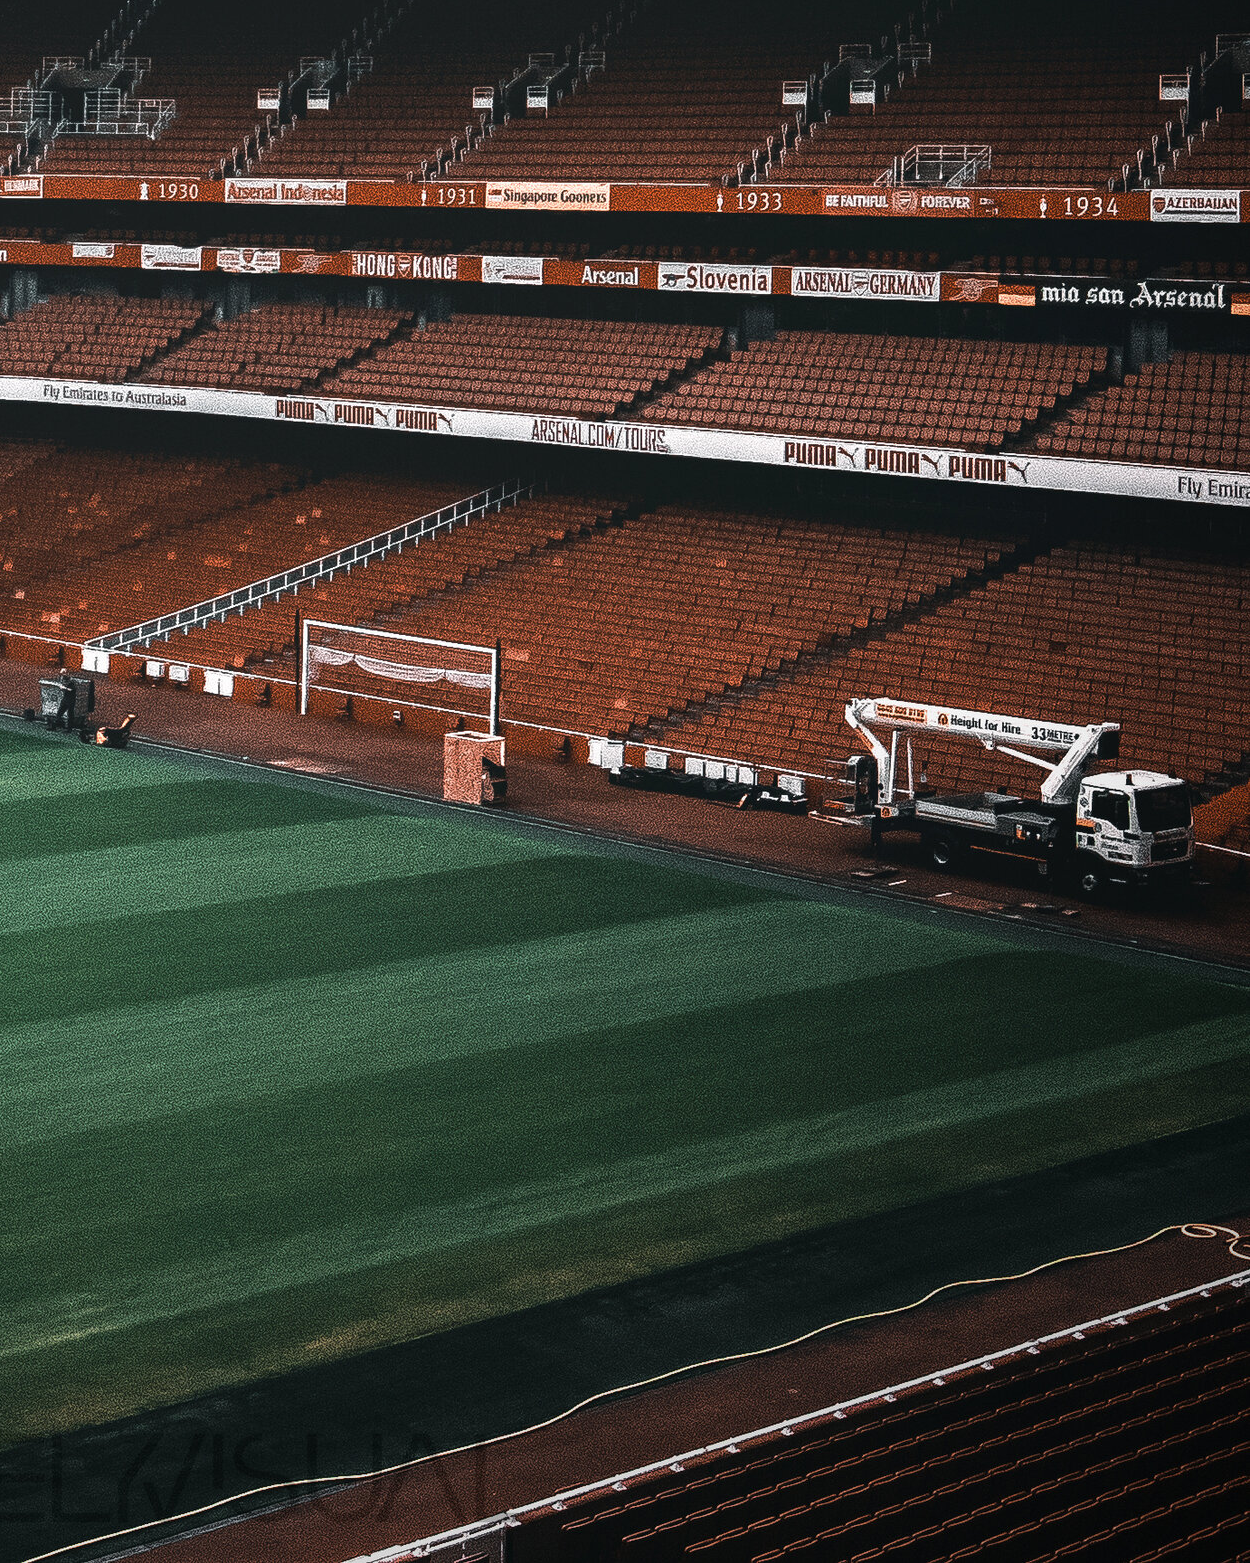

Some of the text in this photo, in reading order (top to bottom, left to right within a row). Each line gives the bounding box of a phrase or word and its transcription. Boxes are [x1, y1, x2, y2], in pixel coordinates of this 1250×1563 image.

[159, 183, 199, 199] 1930
[227, 182, 344, 201] Arsenal Indonesia
[438, 188, 476, 205] 1931
[503, 188, 607, 205] Singapore Gooners
[736, 192, 782, 211] 1933
[825, 195, 840, 207] BE
[841, 195, 888, 208] FAITHFUL
[921, 196, 971, 208] FOREVER
[1064, 196, 1119, 217] 1934
[1166, 197, 1238, 209] AZERBAIJAN
[357, 254, 396, 277] HONG
[412, 256, 451, 280] KONG
[581, 265, 639, 286] Arsenal
[686, 266, 768, 291] Slovenia
[795, 271, 936, 296] ARSENAL GERMANY
[1041, 281, 1227, 308] mia san Arsenal
[43, 384, 187, 406] Fly Emirates to Australasia
[276, 399, 438, 431] PUMA PUMA PUMA
[531, 419, 669, 453] ARSENAL.COM/TOURS
[784, 441, 1007, 481] PUMA PUMA PUMA
[1178, 476, 1202, 499] Fly
[950, 714, 1021, 735] Height for Hire
[1031, 726, 1074, 741] 33 METRE
